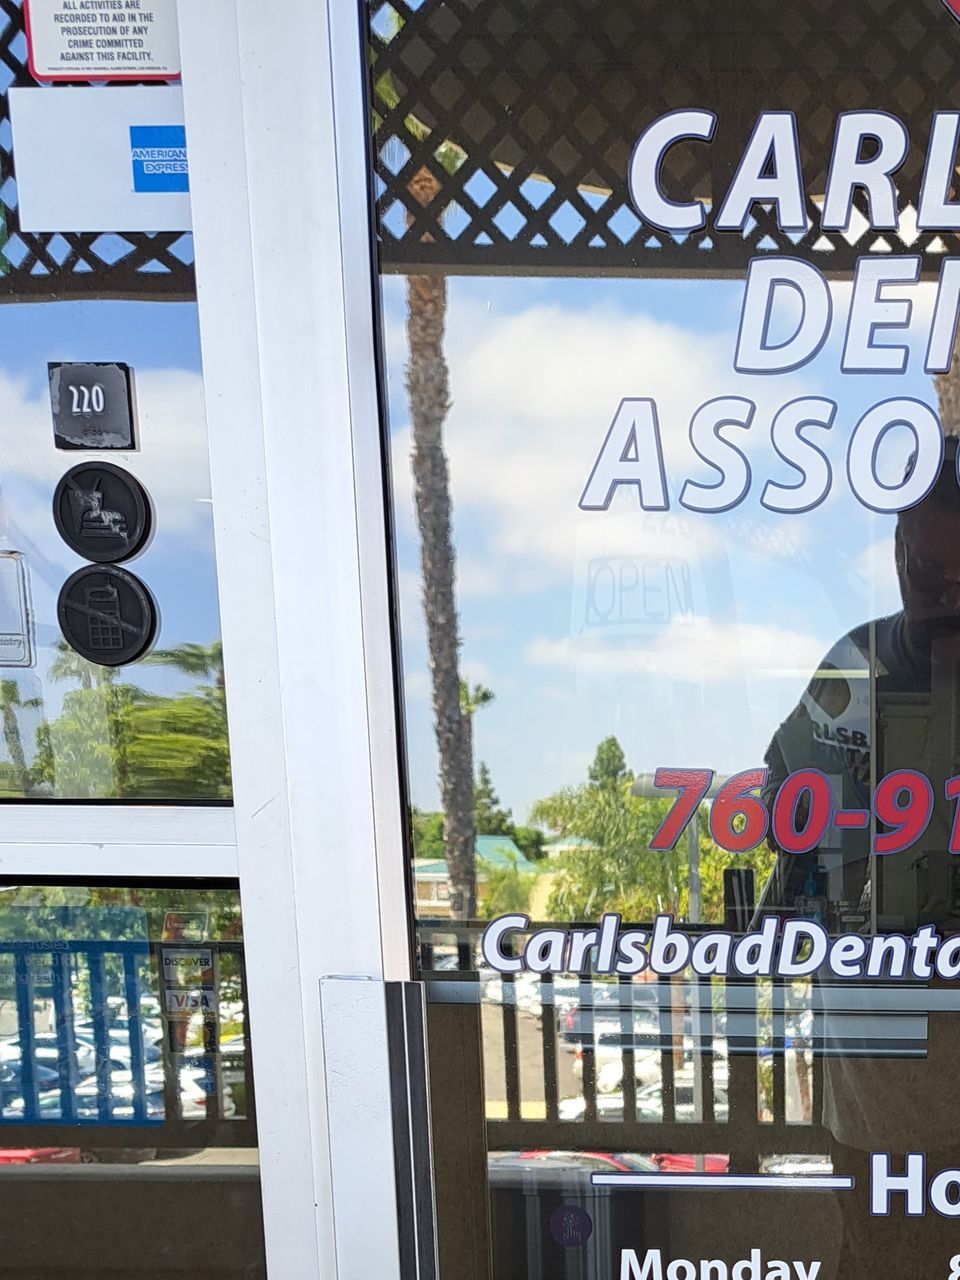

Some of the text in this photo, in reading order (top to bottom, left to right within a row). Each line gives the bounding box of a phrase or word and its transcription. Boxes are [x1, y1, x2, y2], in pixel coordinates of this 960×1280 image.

[62, 0, 141, 10] ALL ACTIVITIES ARE
[54, 12, 154, 24] RECORDED TO AID IN THE
[60, 25, 149, 36] PROSECUTION OF ANY
[67, 39, 144, 49] CRIME COMMITTED
[60, 51, 154, 62] AGAINST THIS FACILITY.
[132, 149, 187, 159] AMERICAN
[68, 385, 105, 414] 220
[592, 560, 690, 622] OPEN
[173, 994, 210, 1008] VISA
